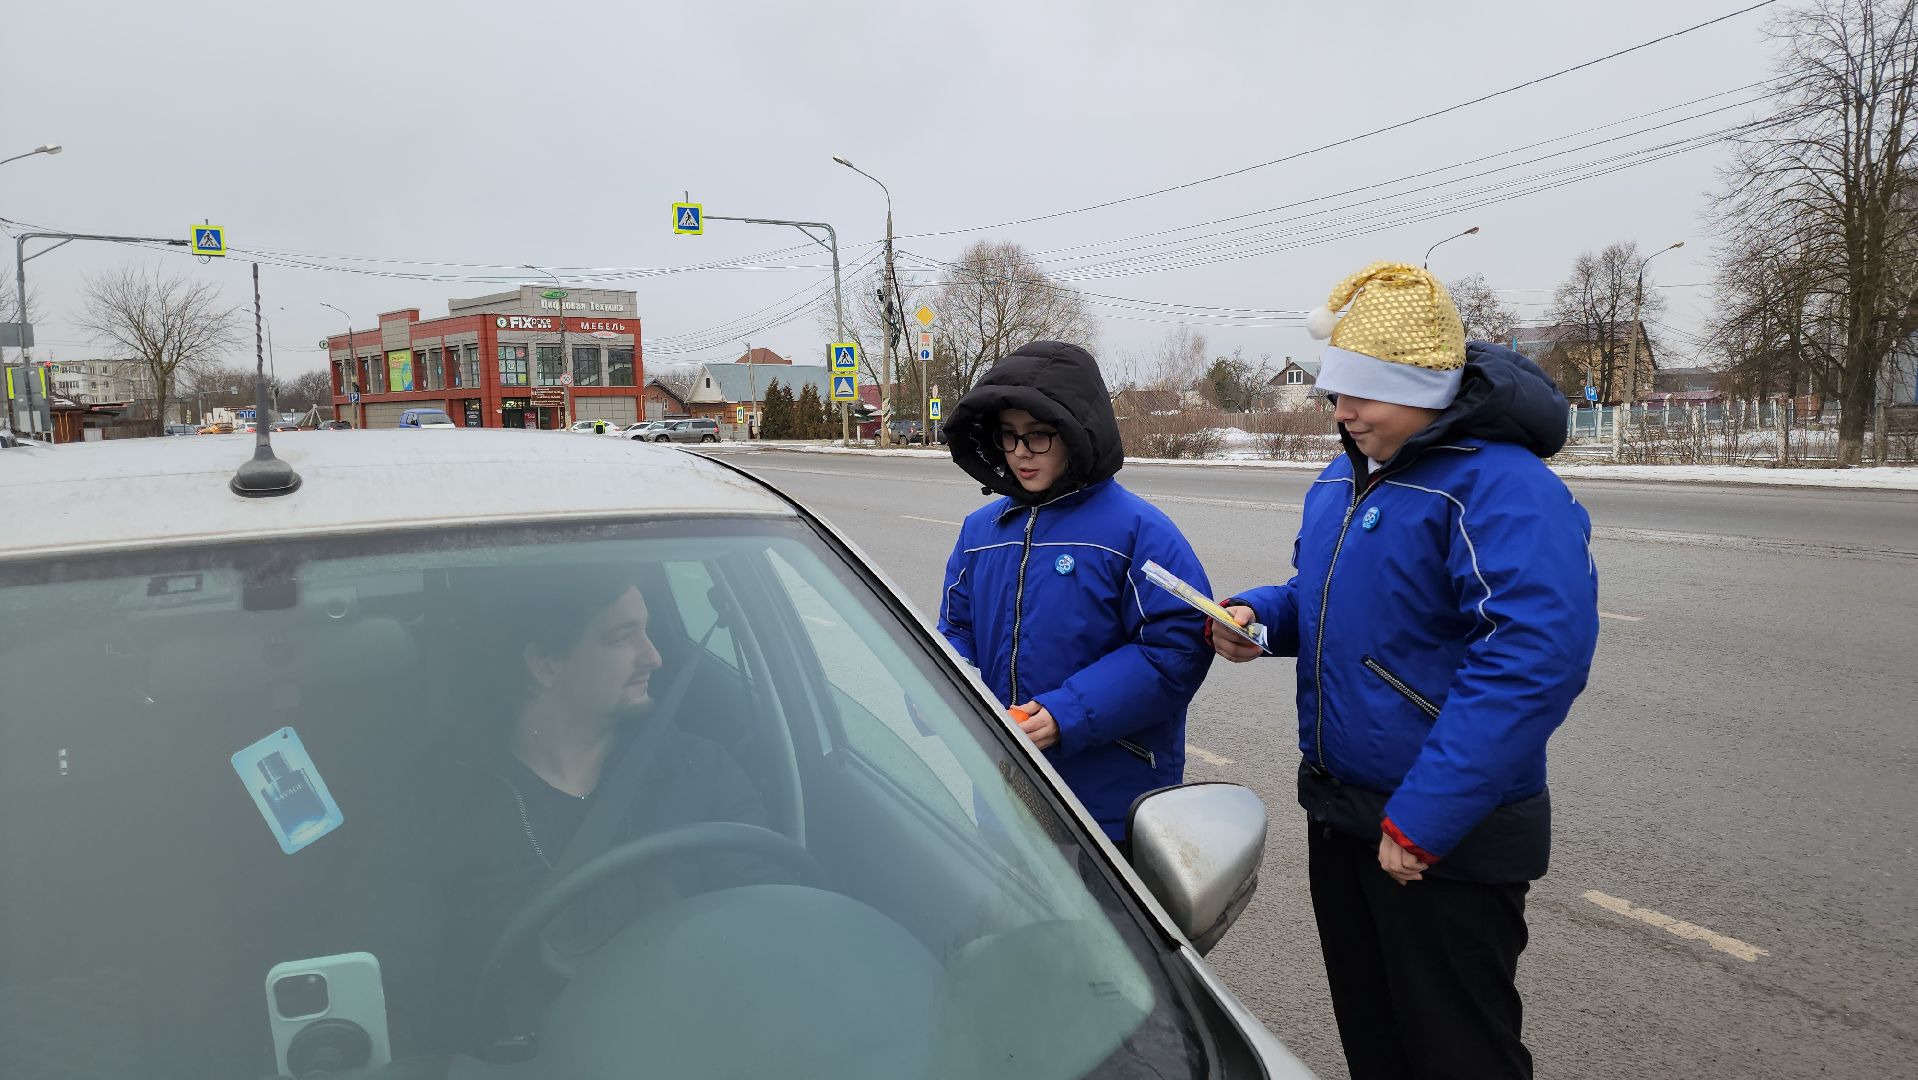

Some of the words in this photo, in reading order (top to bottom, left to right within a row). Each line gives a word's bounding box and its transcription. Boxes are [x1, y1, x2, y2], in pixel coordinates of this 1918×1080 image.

[541, 299, 586, 311] Цифовая
[510, 316, 533, 329] FIX
[580, 321, 625, 331] МЕБЕЛЬ
